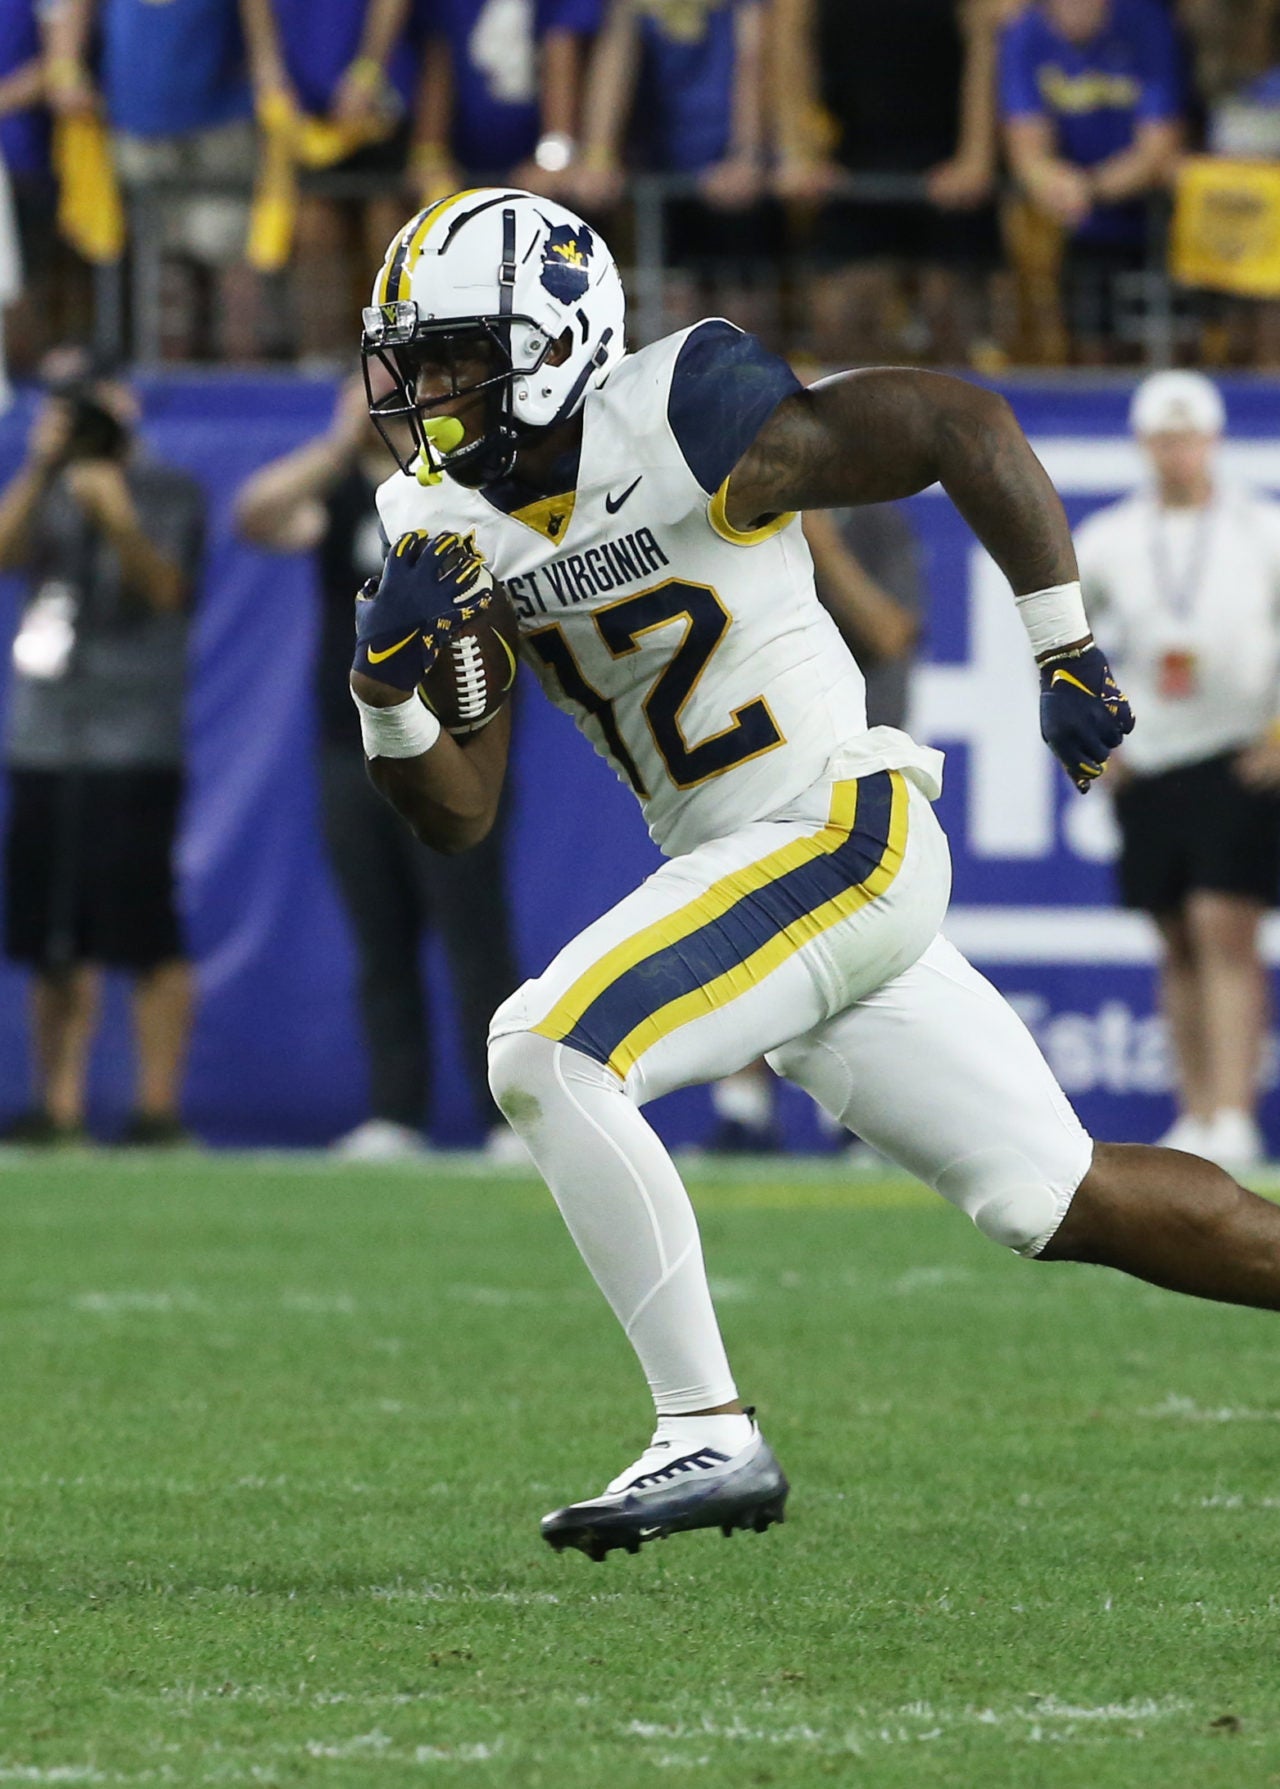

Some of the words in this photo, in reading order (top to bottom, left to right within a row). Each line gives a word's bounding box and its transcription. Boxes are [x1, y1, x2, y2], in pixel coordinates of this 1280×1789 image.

[499, 570, 548, 621] ST
[541, 526, 670, 608] VIRGINIA
[525, 576, 788, 801] 12
